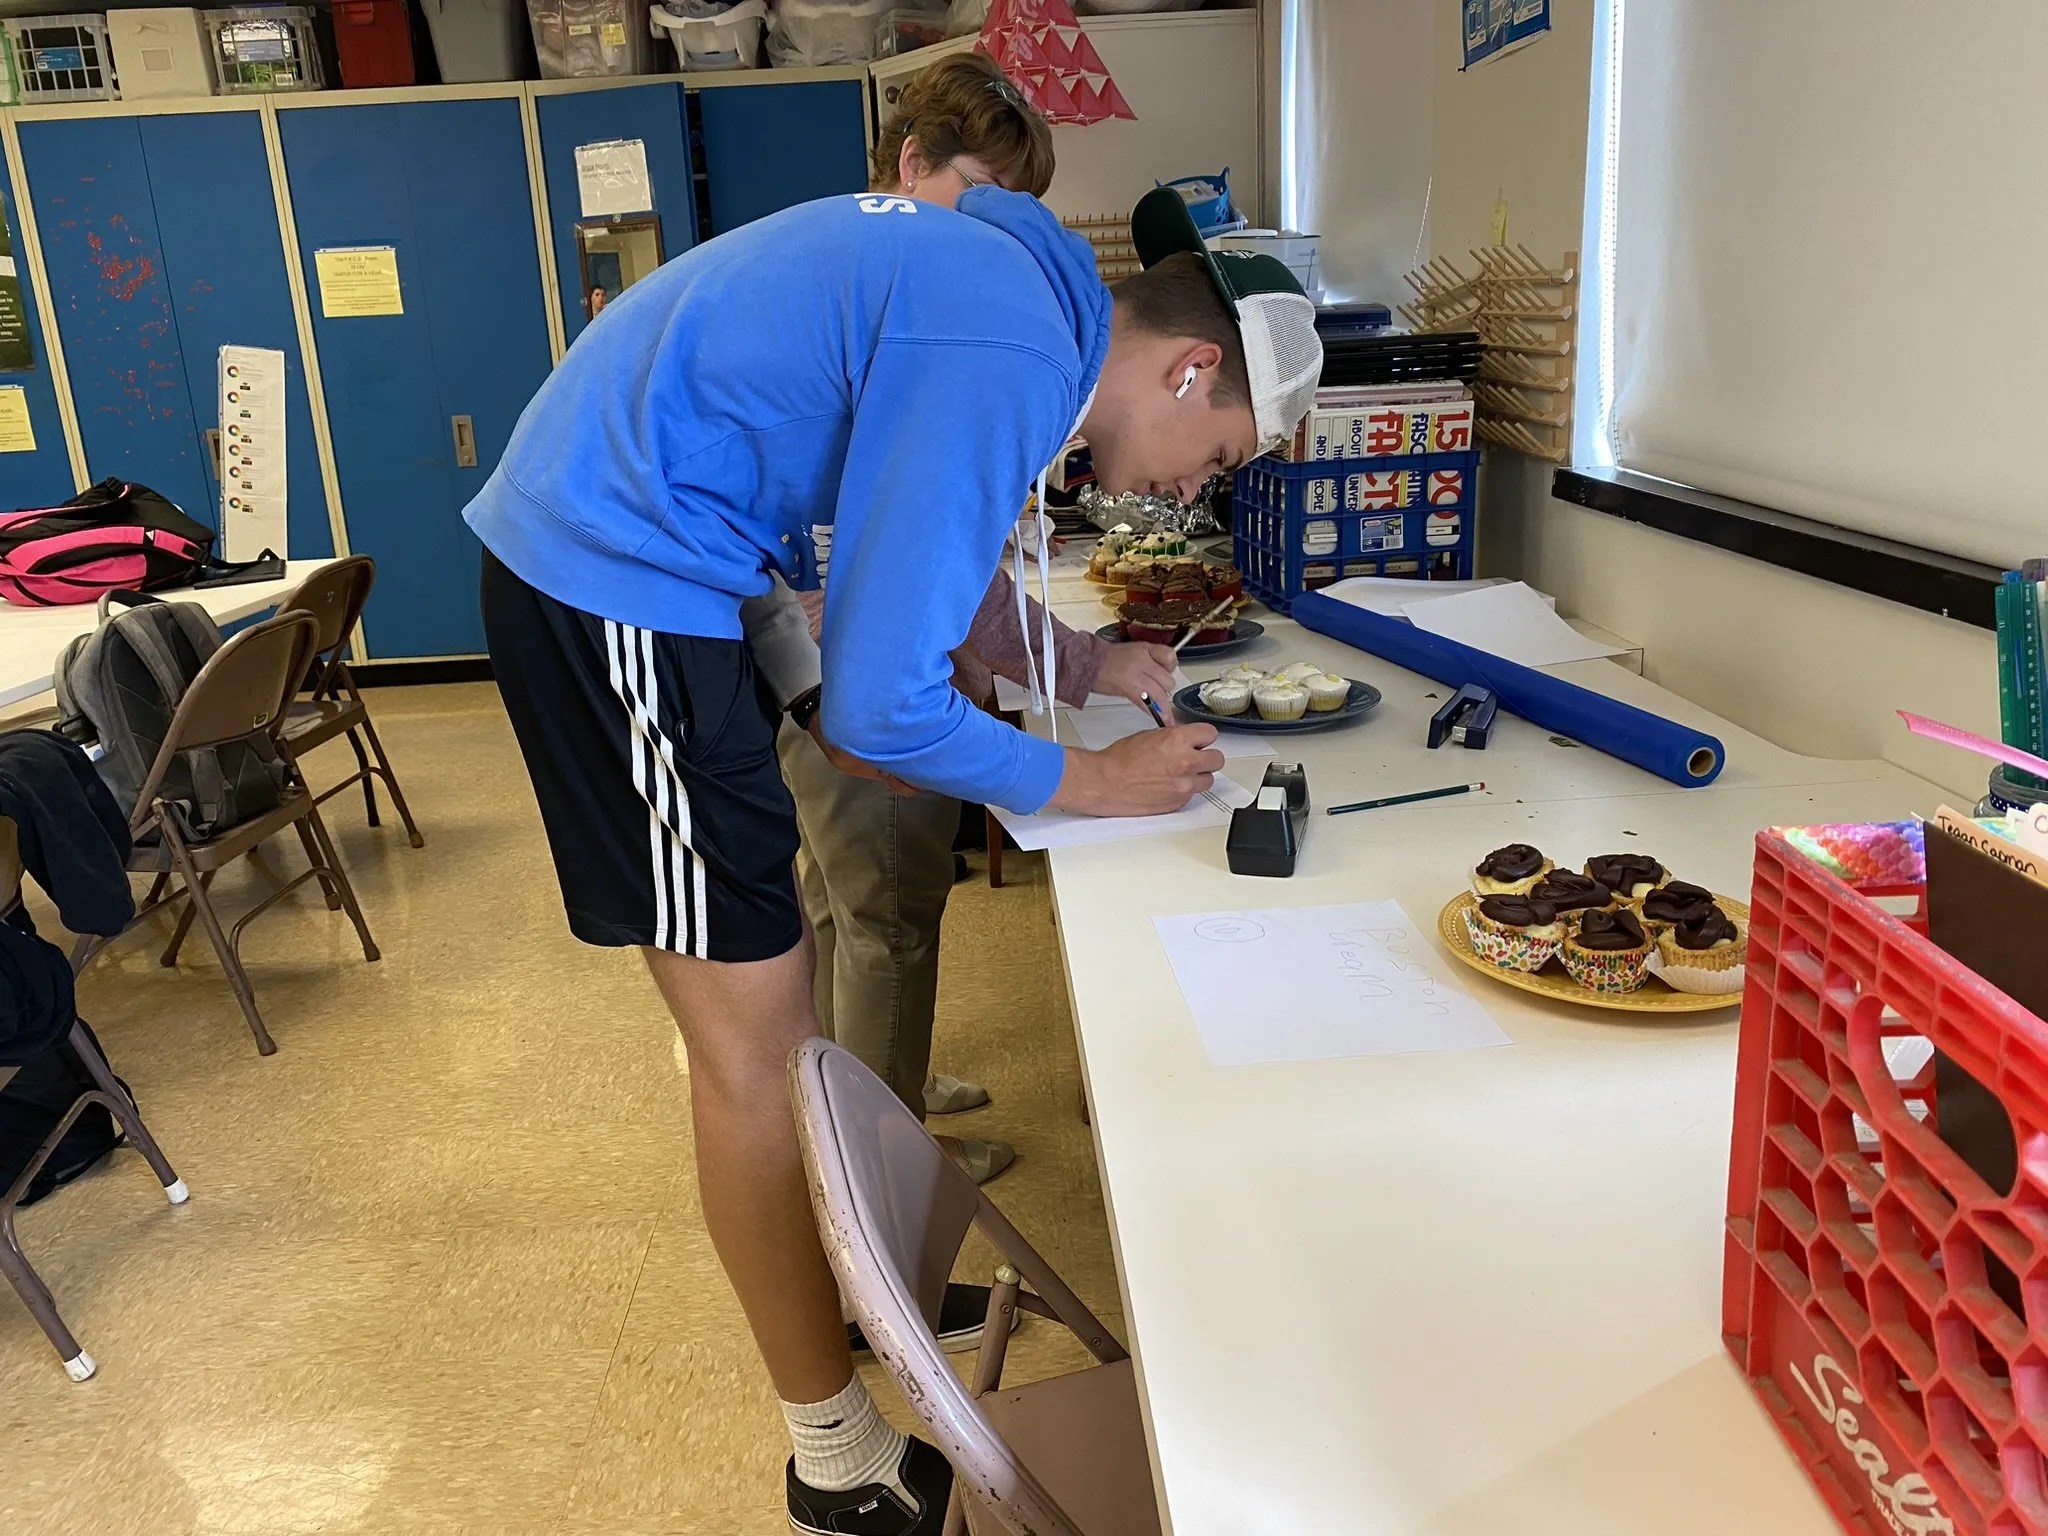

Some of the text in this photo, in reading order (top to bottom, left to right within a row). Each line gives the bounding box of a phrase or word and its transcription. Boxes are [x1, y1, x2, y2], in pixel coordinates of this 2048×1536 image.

[1316, 435, 1327, 456] AND
[1347, 419, 1363, 512] ABOUT UNIVER
[1313, 480, 1325, 511] EOPLE
[1790, 1353, 1955, 1536] Sealt
